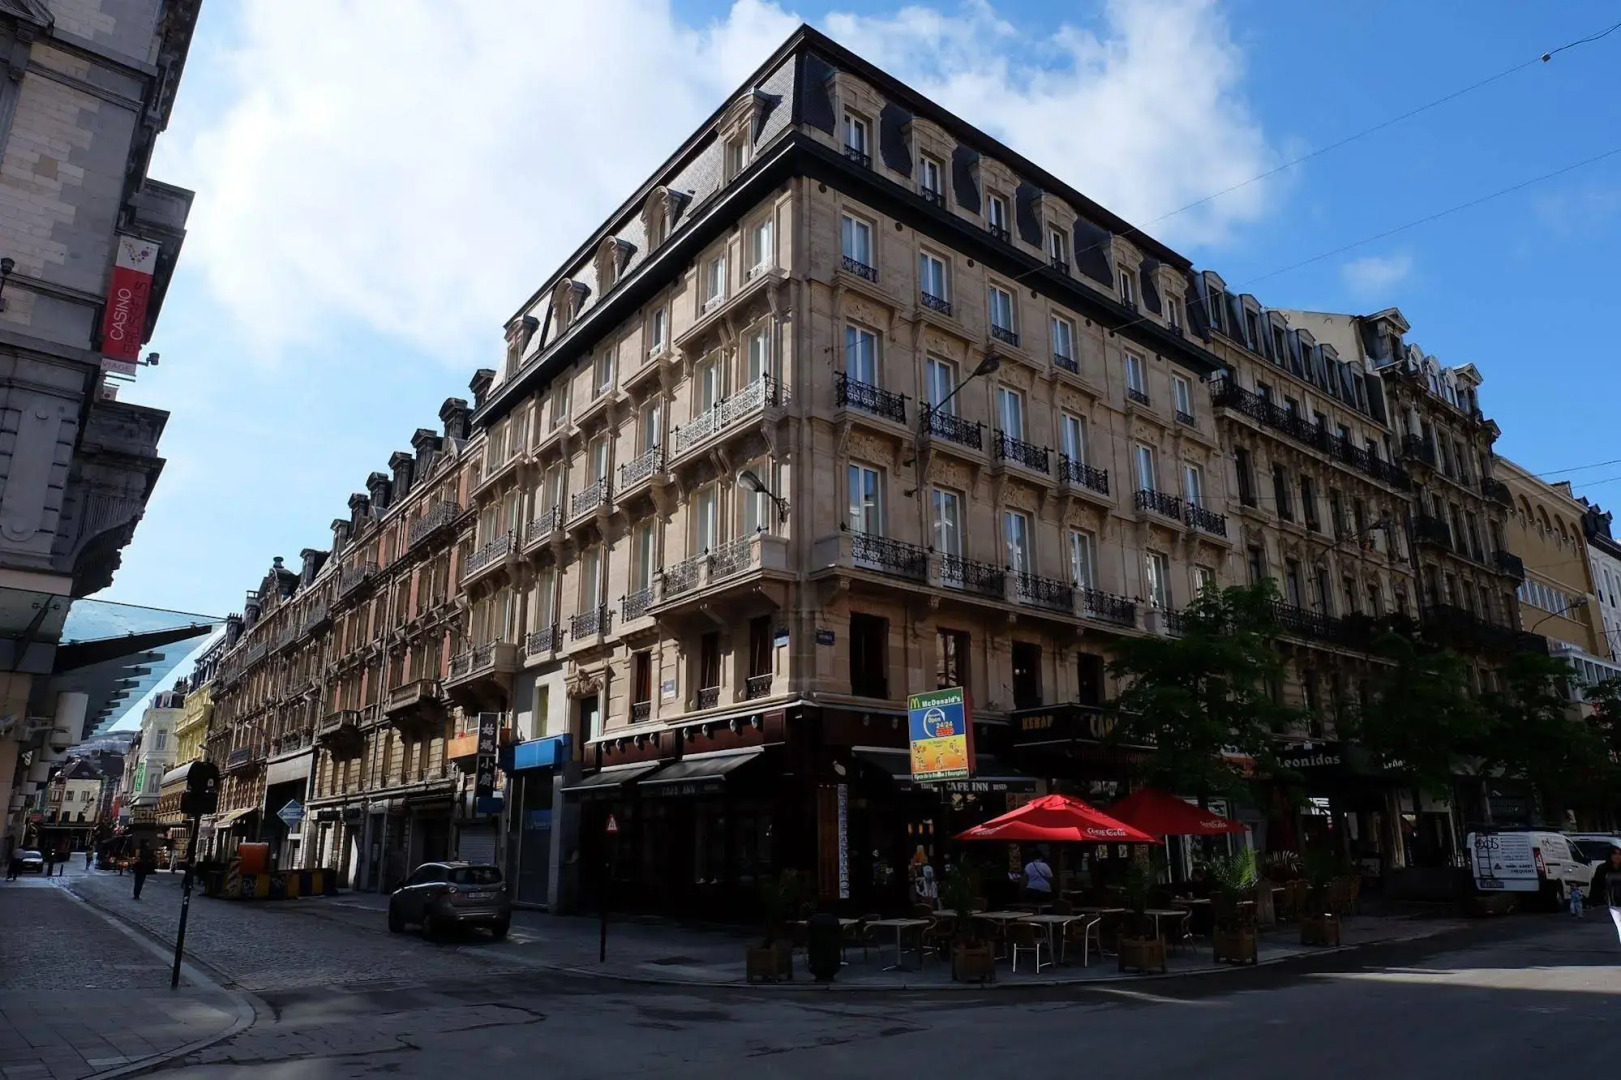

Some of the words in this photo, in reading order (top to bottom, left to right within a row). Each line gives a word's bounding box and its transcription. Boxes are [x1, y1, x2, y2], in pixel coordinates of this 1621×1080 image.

[110, 288, 132, 341] CASINO
[123, 281, 147, 354] BRUSSELS
[922, 695, 961, 708] McDonald's
[971, 781, 989, 792] INN
